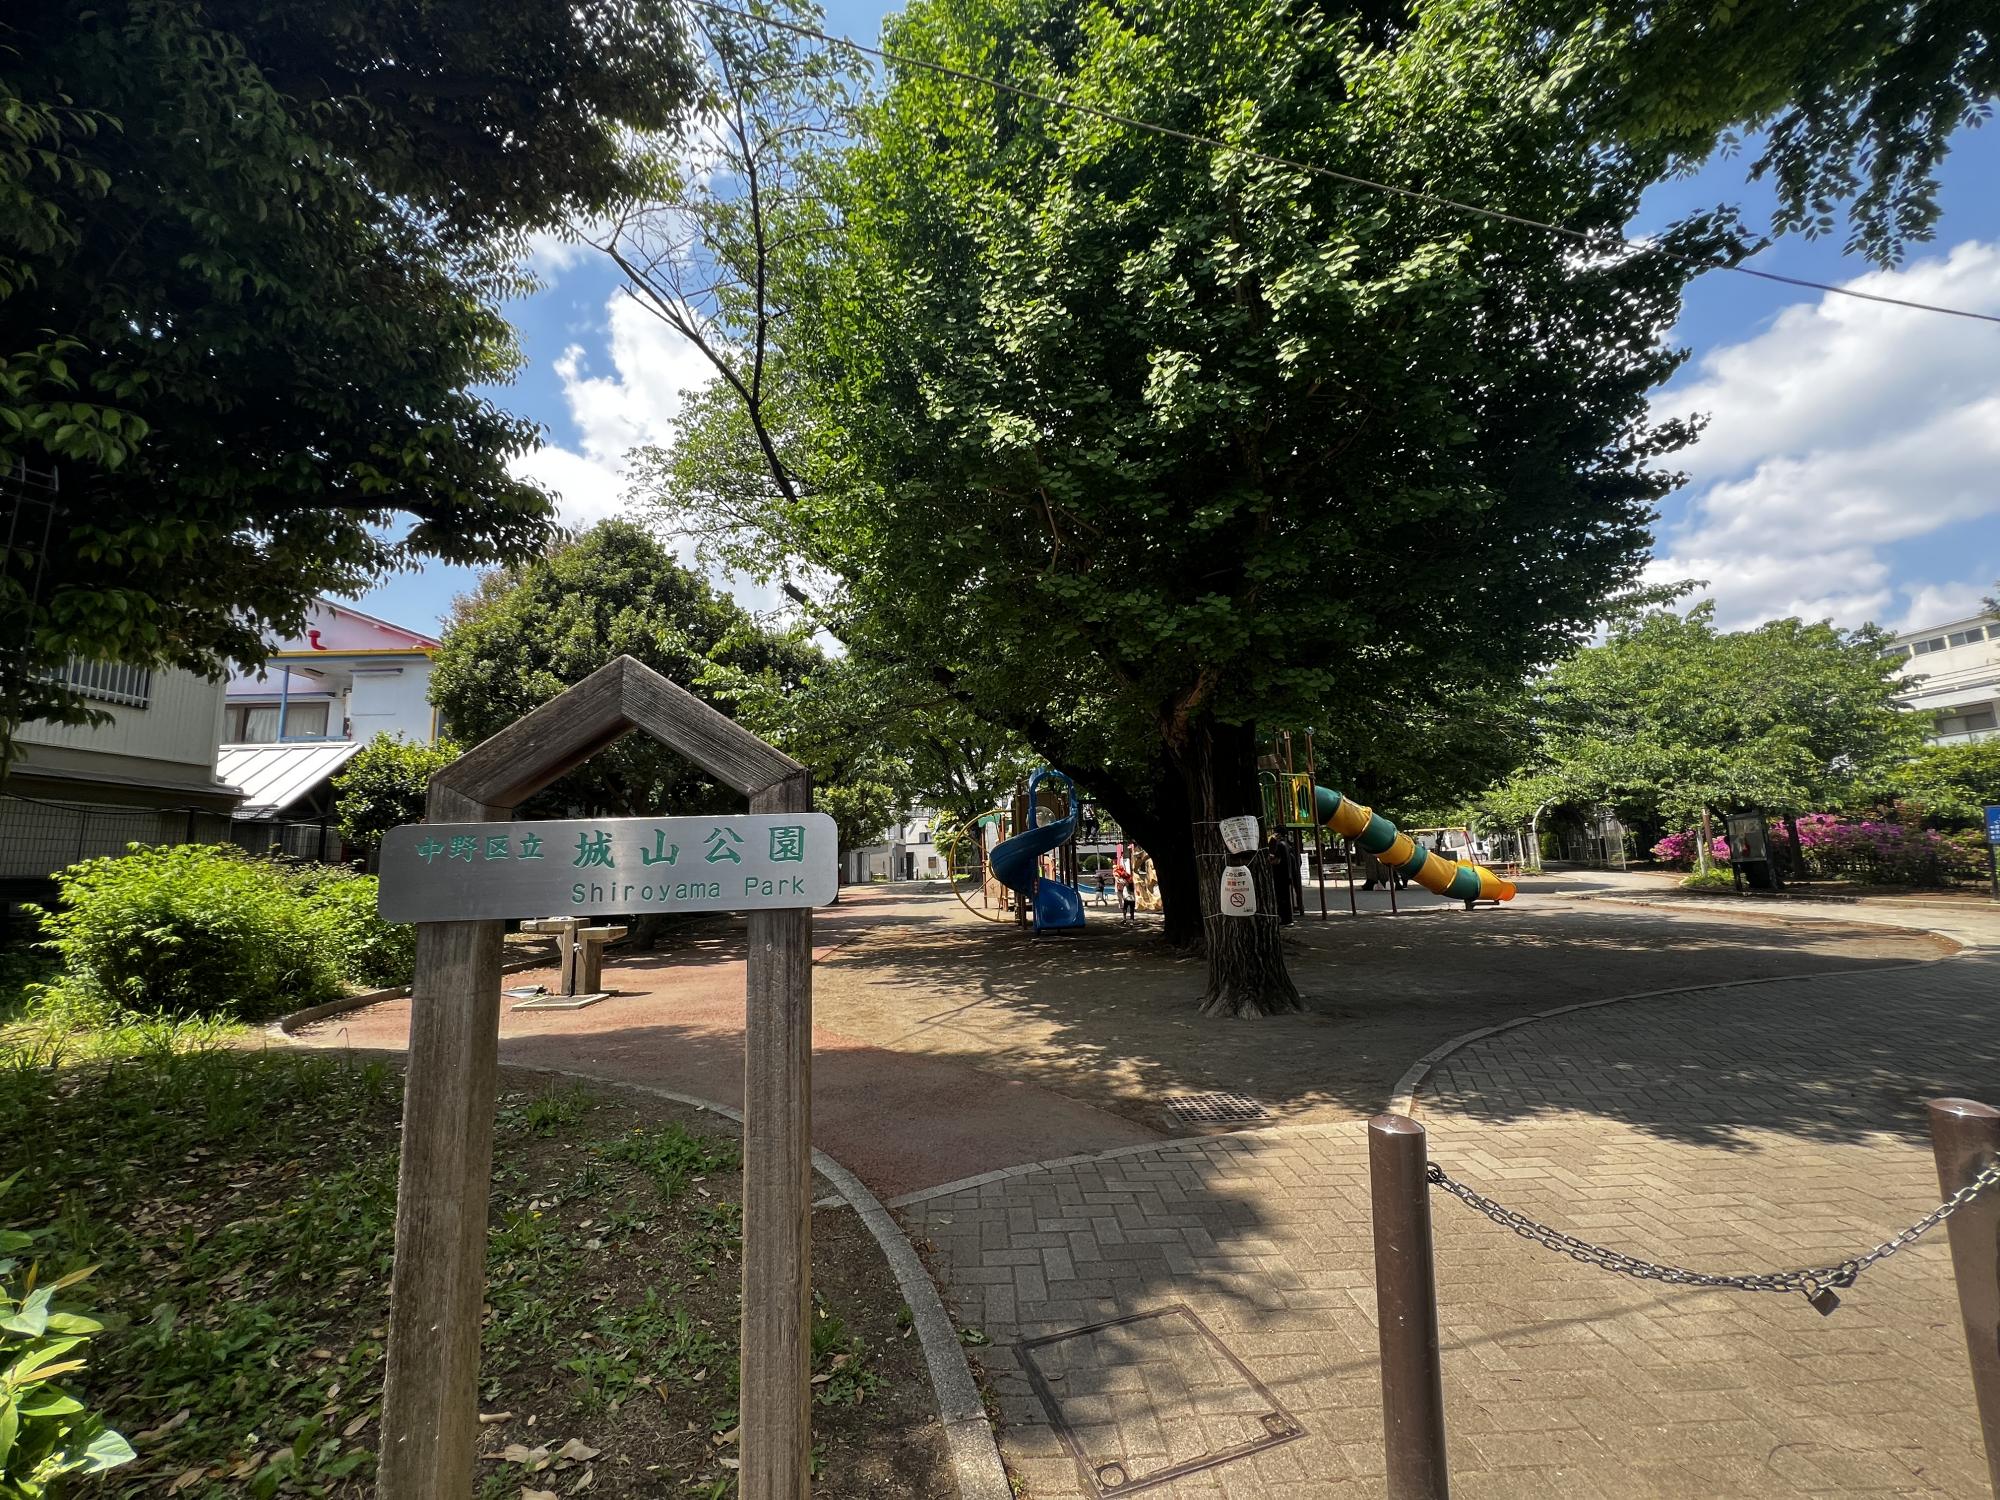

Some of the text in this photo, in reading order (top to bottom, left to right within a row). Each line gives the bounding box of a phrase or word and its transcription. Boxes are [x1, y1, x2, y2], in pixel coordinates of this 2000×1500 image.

[416, 825, 806, 869] 中野区立 城山公園
[571, 876, 806, 905] Shiroyama Park
